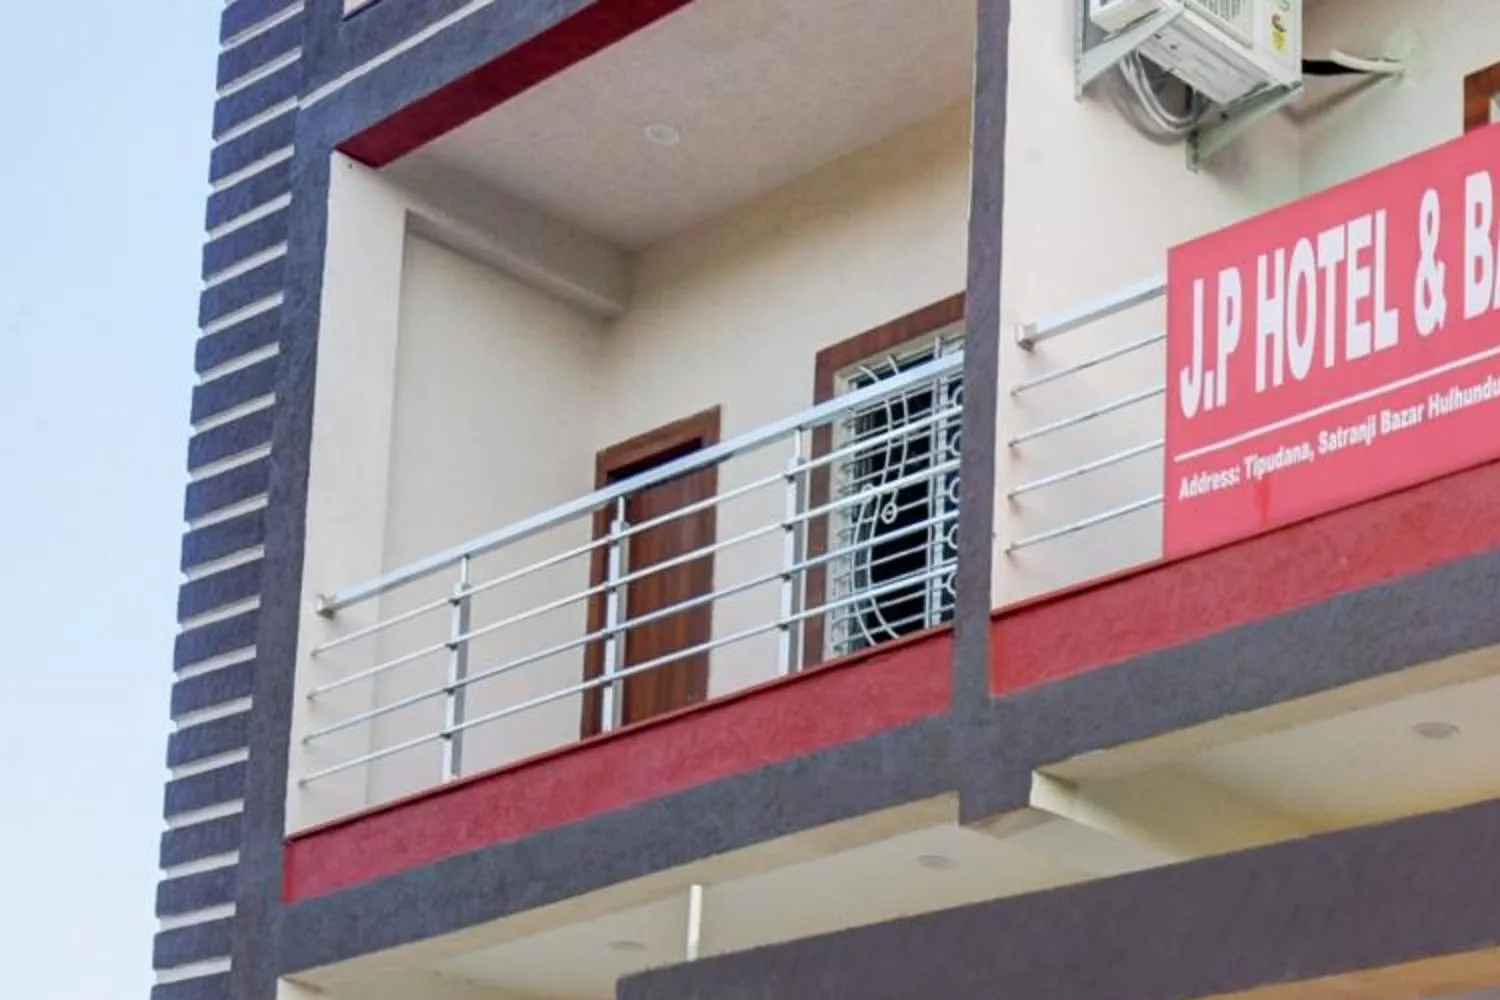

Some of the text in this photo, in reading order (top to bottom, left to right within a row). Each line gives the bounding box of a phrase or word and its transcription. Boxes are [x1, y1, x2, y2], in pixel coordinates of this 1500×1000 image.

[1179, 265, 1243, 419] J.P
[1255, 209, 1399, 393] HOTEL
[1414, 187, 1448, 337] &
[1179, 467, 1241, 501] Address:
[1318, 414, 1376, 455] Satranji
[1381, 404, 1425, 435] Bazar
